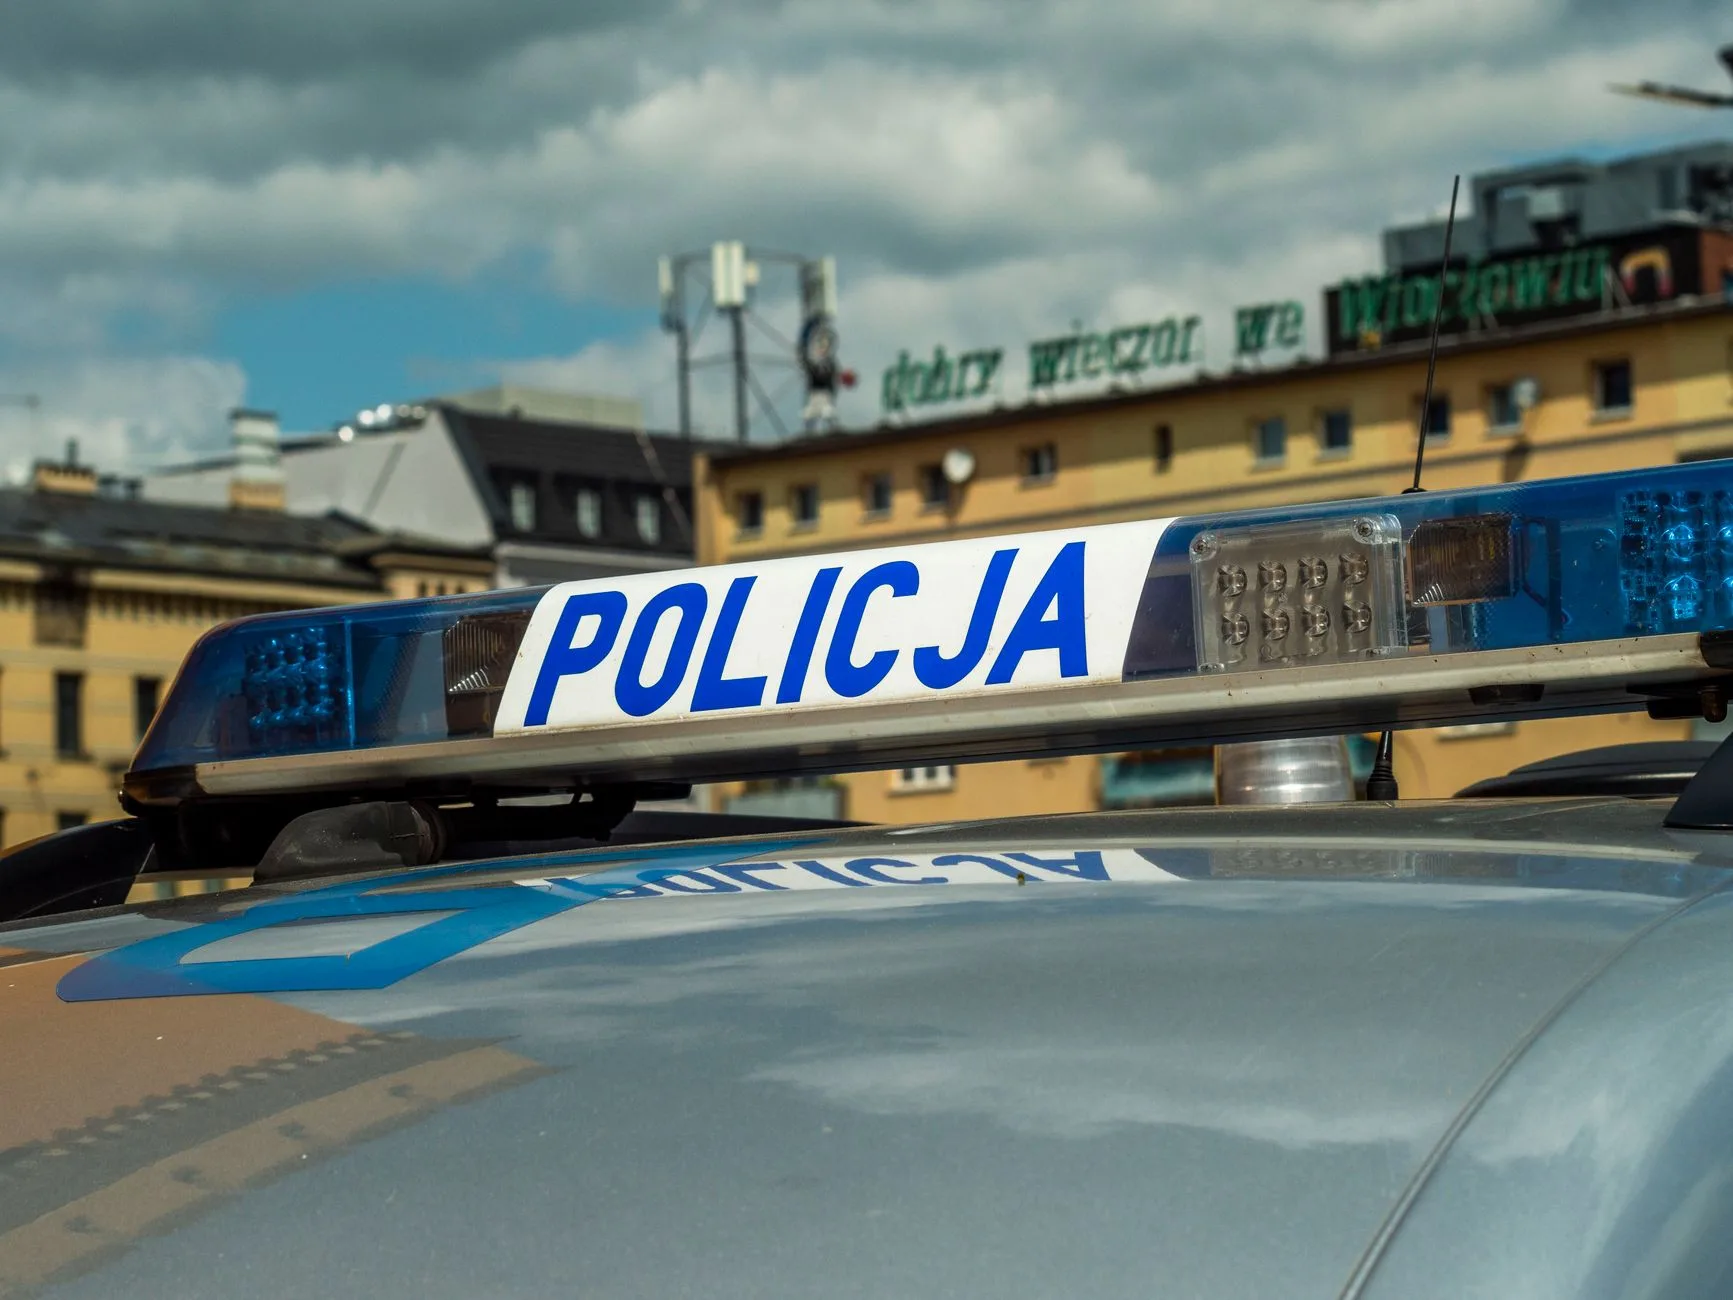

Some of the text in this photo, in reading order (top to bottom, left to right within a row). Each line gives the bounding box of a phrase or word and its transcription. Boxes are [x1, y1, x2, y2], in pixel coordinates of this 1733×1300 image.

[881, 342, 1003, 412] dobry
[1236, 300, 1306, 355] we
[524, 541, 1088, 727] POLICJA
